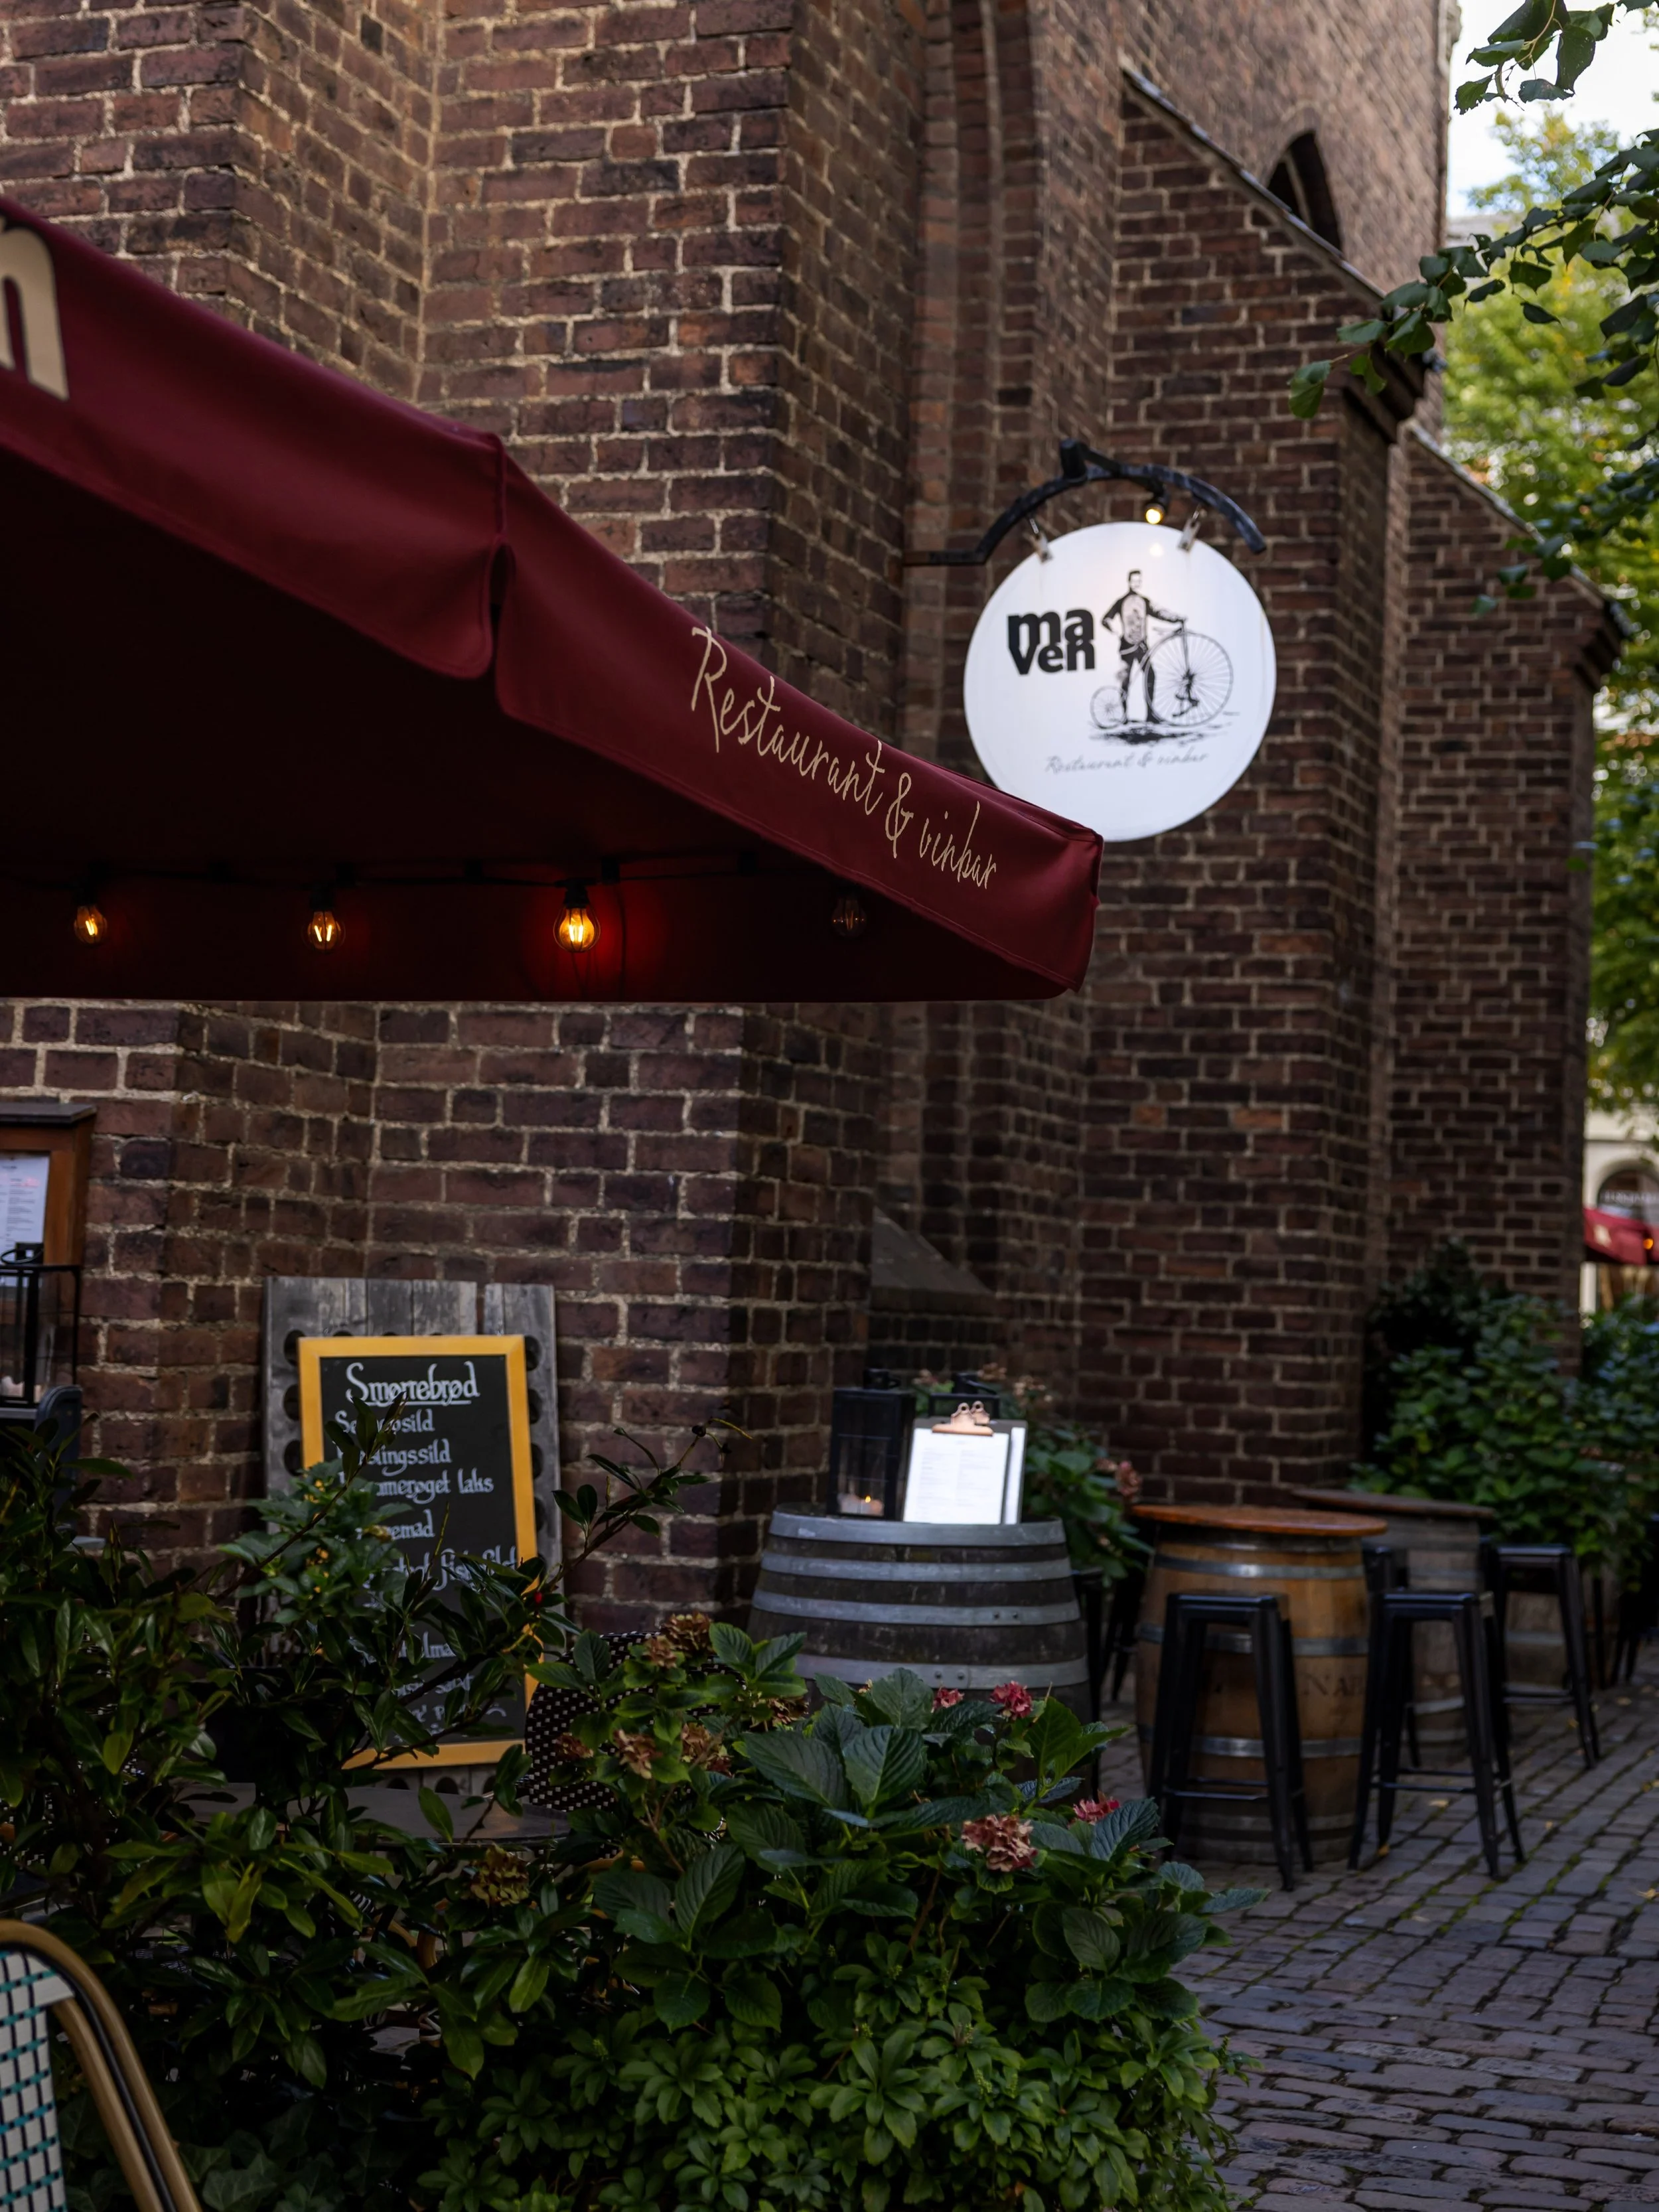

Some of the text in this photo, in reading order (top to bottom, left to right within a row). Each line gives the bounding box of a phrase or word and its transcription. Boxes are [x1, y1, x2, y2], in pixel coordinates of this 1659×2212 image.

[691, 626, 996, 889] Restaurant & vinbar
[1044, 751, 1135, 774] Restaurant
[1137, 747, 1153, 769] &
[344, 1361, 480, 1406] Smørrebrød
[457, 1467, 495, 1495] laks
